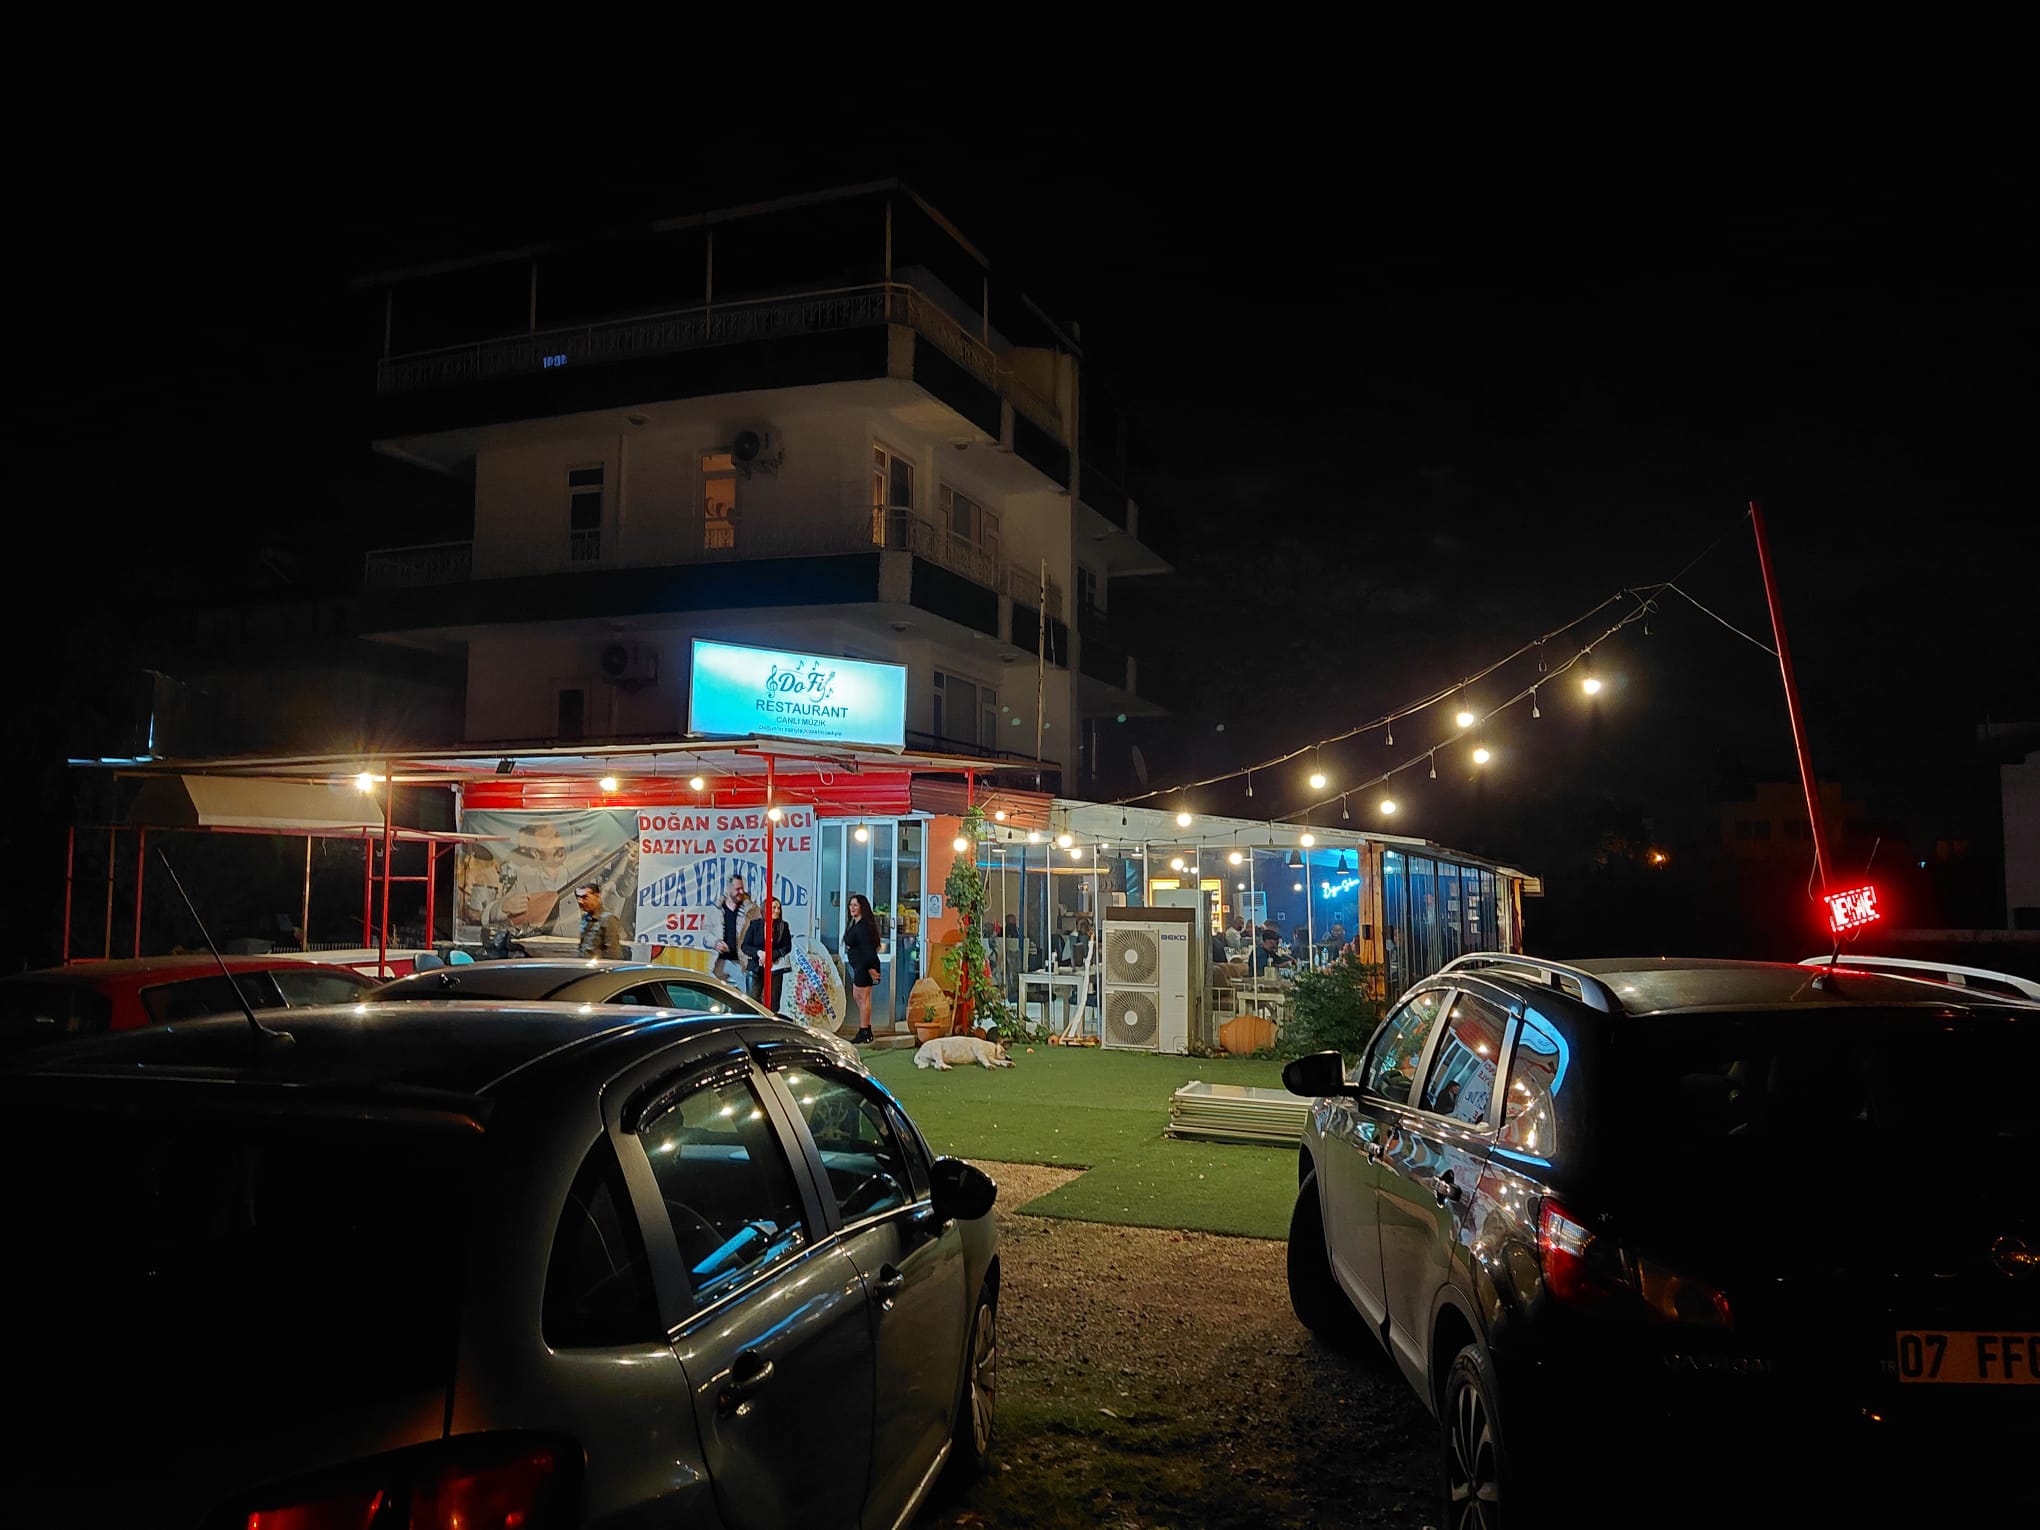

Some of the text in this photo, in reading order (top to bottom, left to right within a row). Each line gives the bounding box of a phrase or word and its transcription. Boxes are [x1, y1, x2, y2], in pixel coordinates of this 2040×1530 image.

[756, 699, 848, 718] RESTAURANT
[776, 716, 800, 725] CANLI
[639, 812, 709, 831] DOĞAN
[642, 838, 716, 854] SAZIYLA
[639, 868, 688, 907] PUPA
[1901, 1334, 1948, 1378] 07
